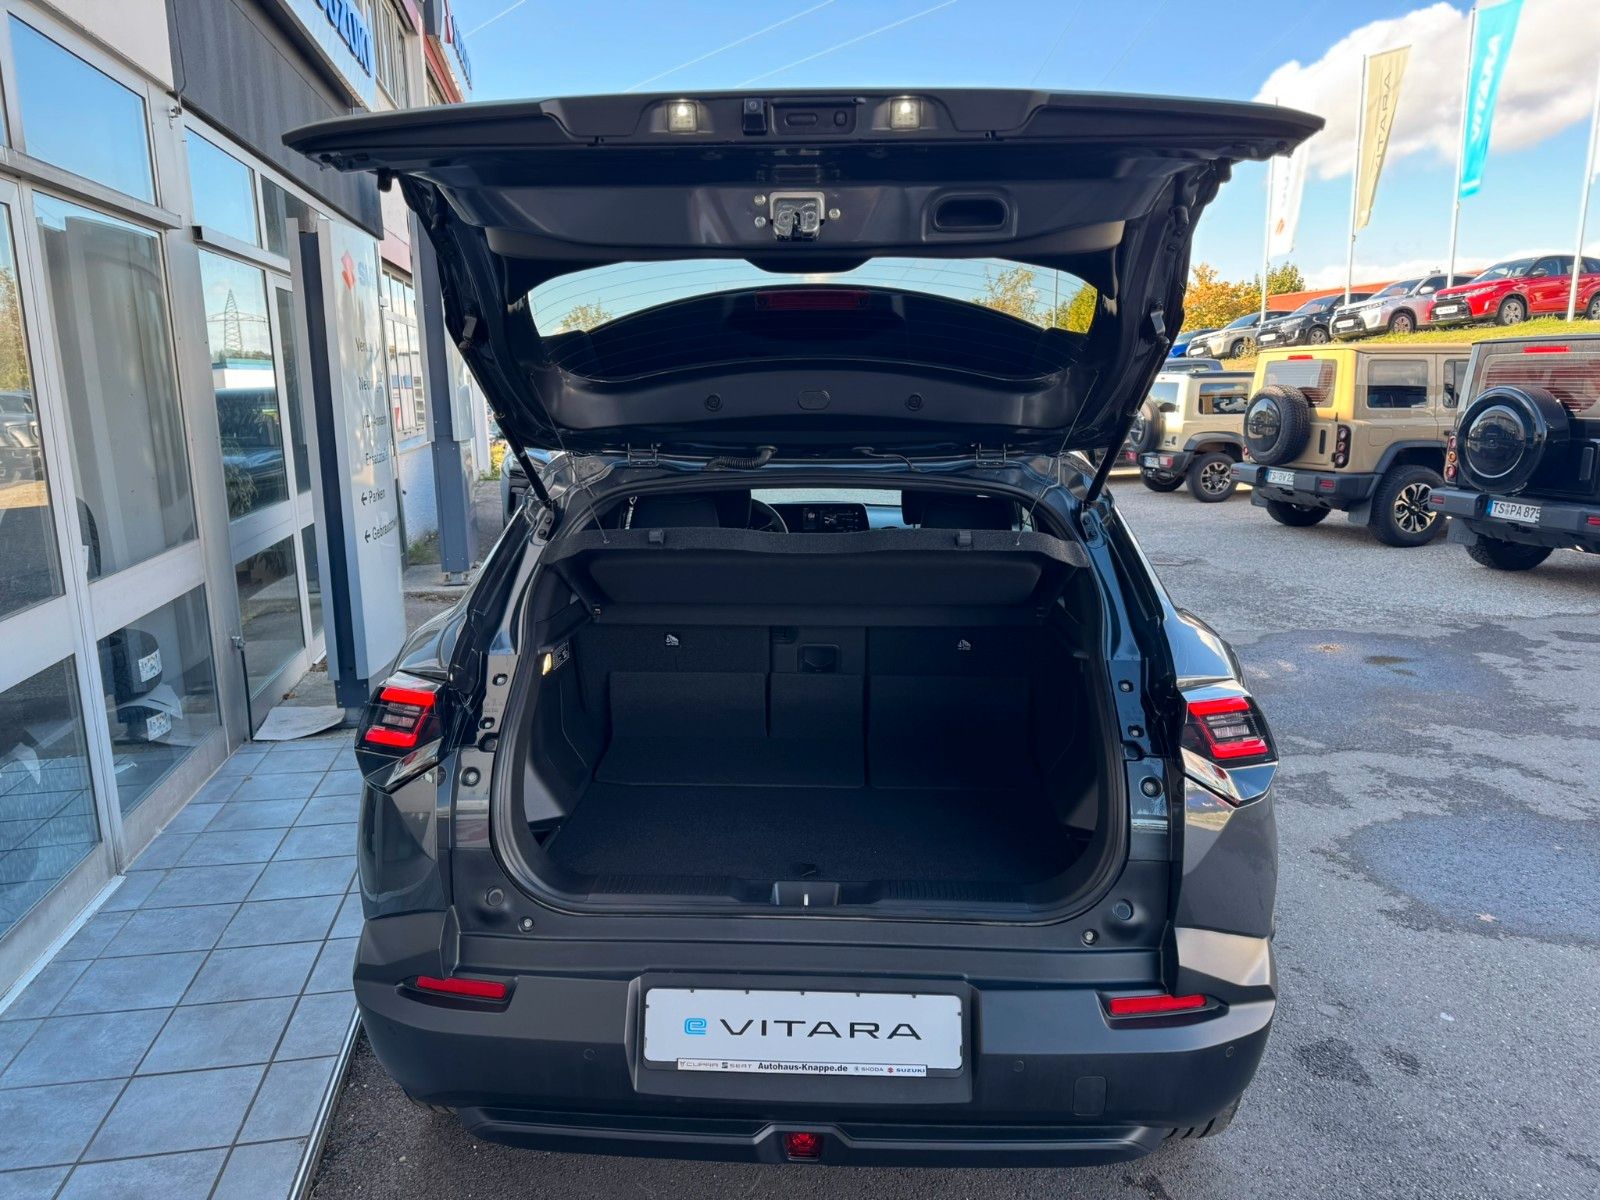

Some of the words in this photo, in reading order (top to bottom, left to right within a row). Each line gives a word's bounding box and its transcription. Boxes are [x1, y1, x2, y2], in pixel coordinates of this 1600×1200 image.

[368, 488, 386, 504] Parken
[1493, 502, 1506, 514] TS
[1510, 504, 1522, 517] PA
[719, 1018, 922, 1041] VITARA
[758, 1062, 848, 1074] Autohaus-Knappe.de
